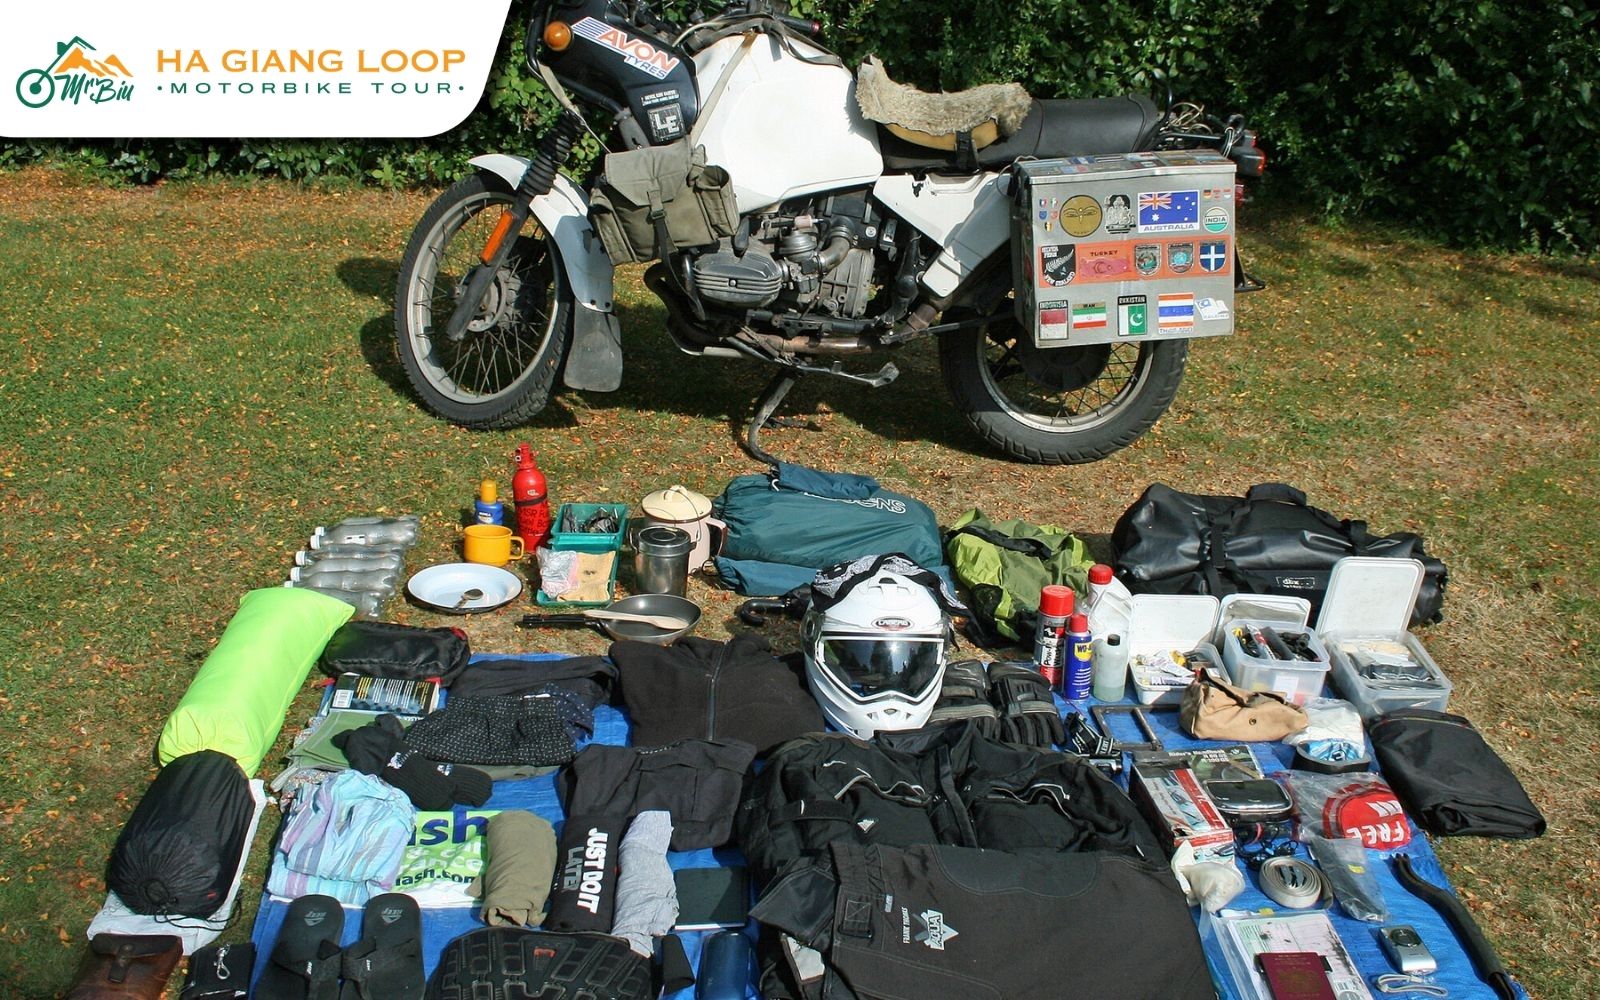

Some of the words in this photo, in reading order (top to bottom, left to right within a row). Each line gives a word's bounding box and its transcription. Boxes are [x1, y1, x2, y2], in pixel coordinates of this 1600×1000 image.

[598, 29, 678, 71] AVON
[625, 55, 668, 79] TYRES
[1143, 224, 1195, 232] AUSTRALIA
[584, 827, 608, 870] JUST
